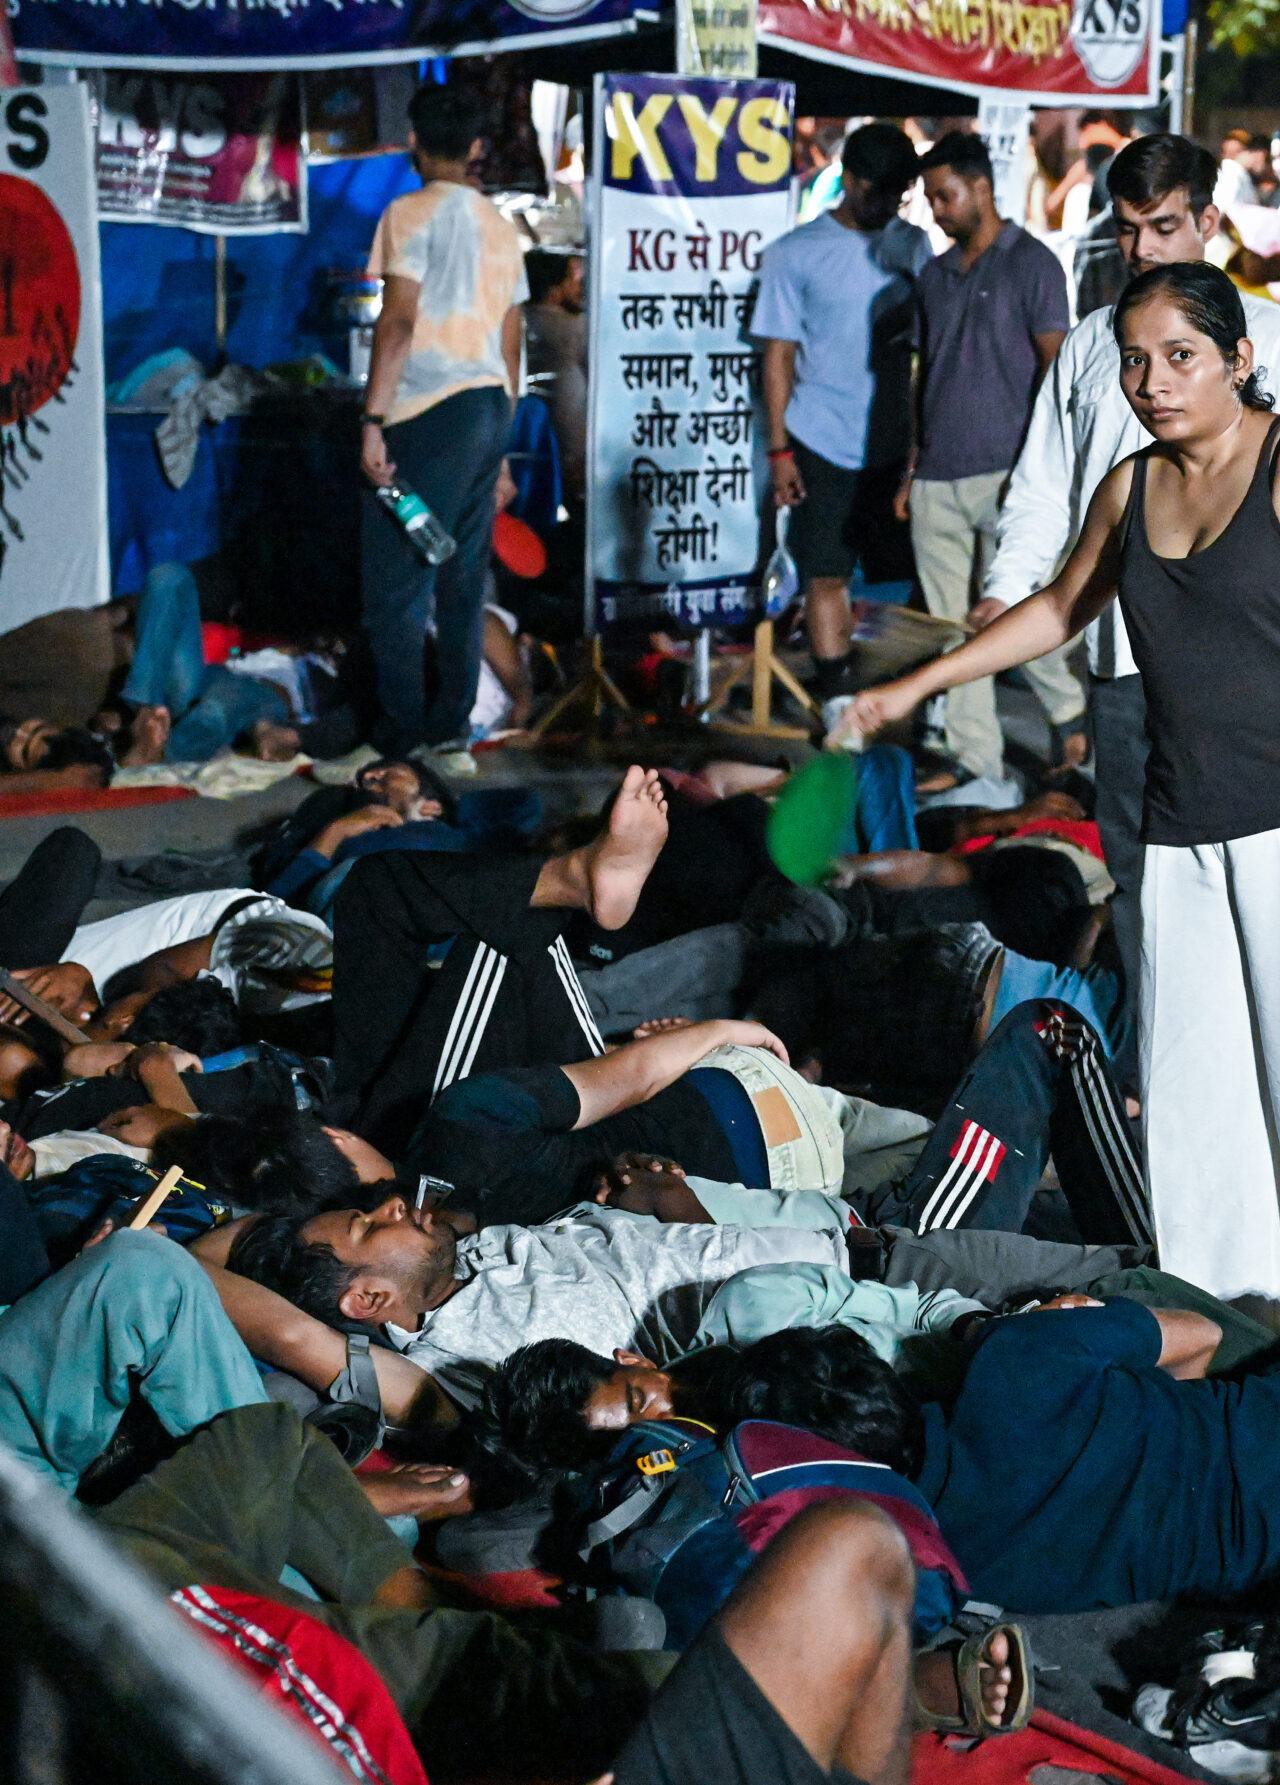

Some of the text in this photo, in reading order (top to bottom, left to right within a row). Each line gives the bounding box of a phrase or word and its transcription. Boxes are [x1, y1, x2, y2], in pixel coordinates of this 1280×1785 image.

[0, 94, 50, 170] S
[611, 92, 792, 184] KYS
[627, 220, 763, 272] KG से PG
[619, 294, 666, 330] तक
[671, 279, 729, 330] सभी
[620, 354, 697, 397] समान,
[632, 395, 752, 447] और अच्छी
[631, 454, 751, 513] शिक्षा देनी
[652, 512, 718, 571] होगी!
